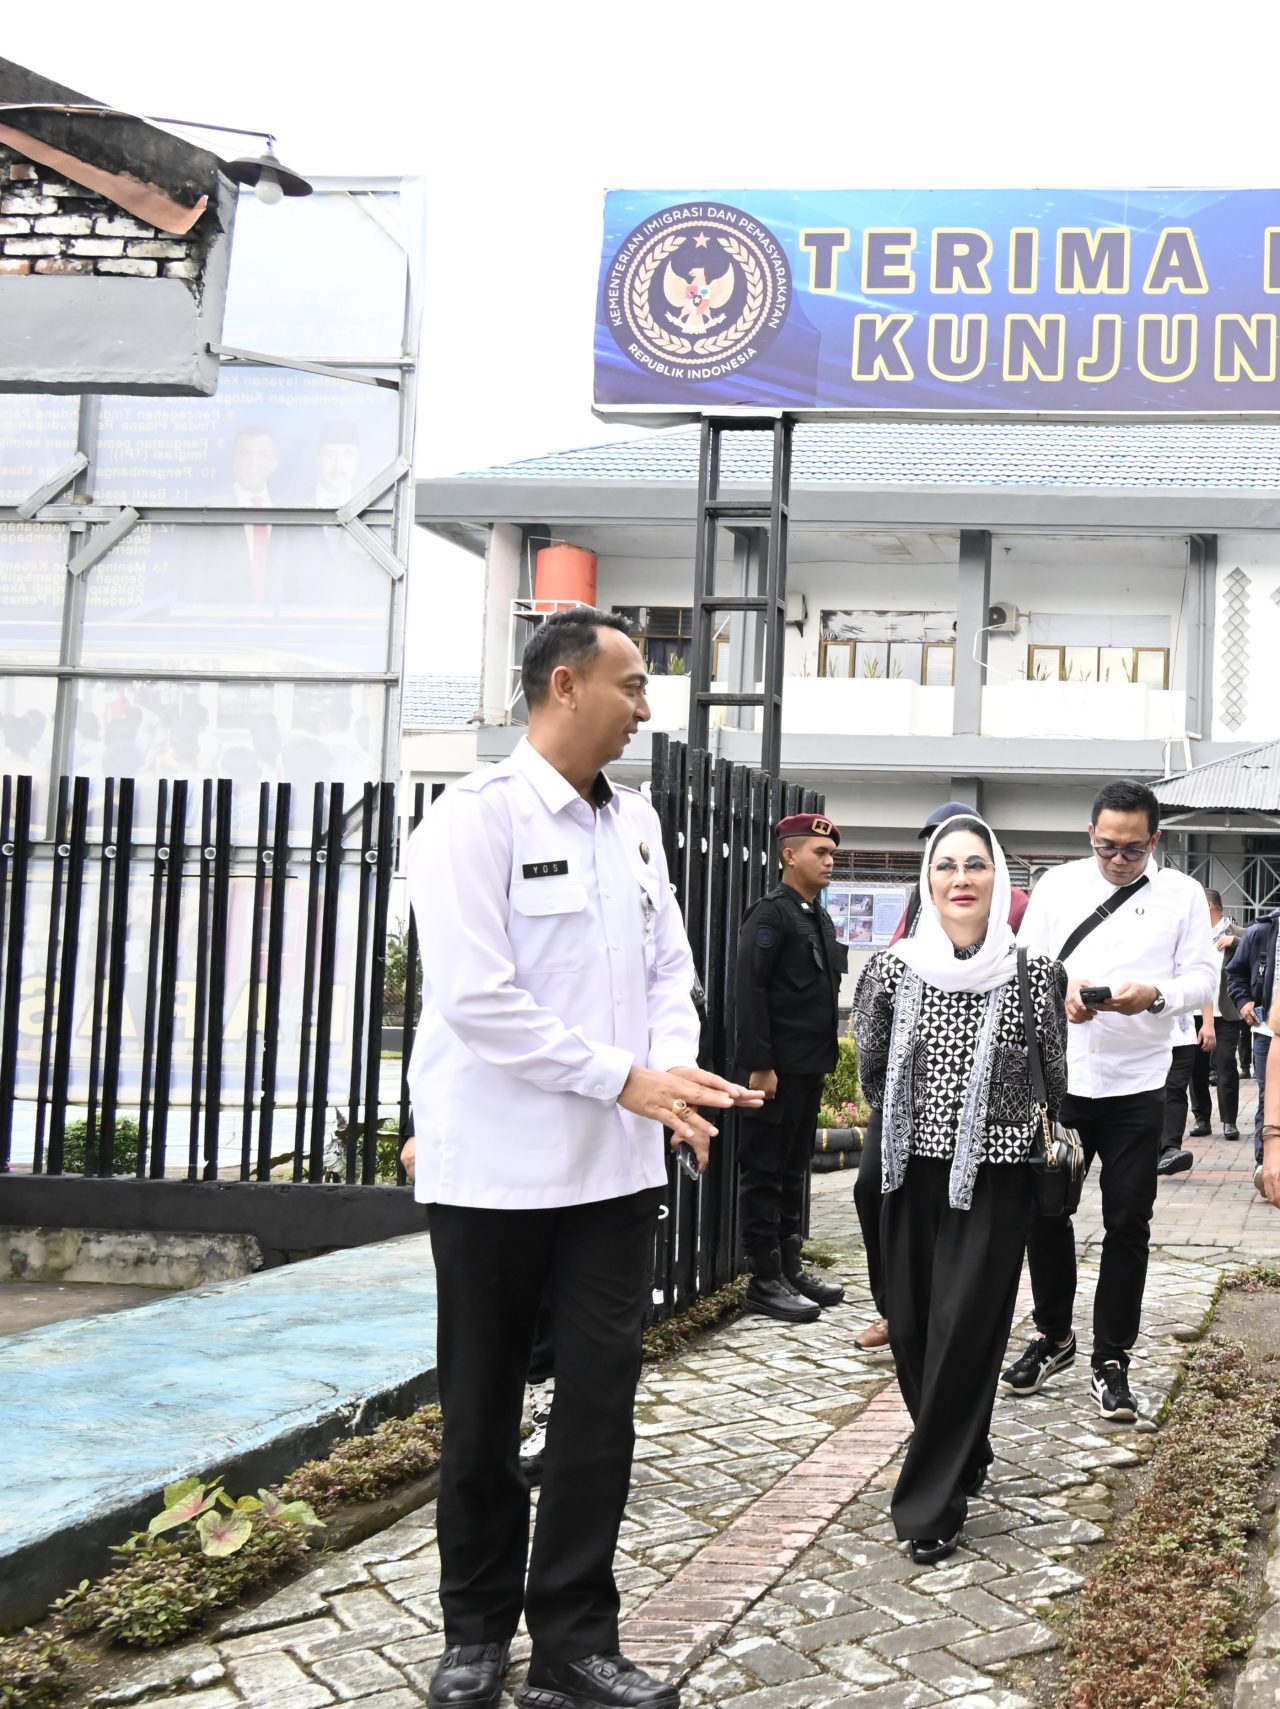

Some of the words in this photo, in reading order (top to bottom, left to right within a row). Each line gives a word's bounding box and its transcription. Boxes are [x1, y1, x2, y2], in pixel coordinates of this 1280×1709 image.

[608, 235, 644, 327] KEMENTERIAN
[643, 207, 703, 235] IMIGRASI
[707, 207, 737, 223] DAN
[738, 217, 788, 328] PEMASYARAKATAN
[799, 226, 1208, 294] TERIMA
[628, 343, 685, 378] REPUBLIK
[687, 348, 757, 379] INDONESIA
[532, 863, 559, 875] YOS
